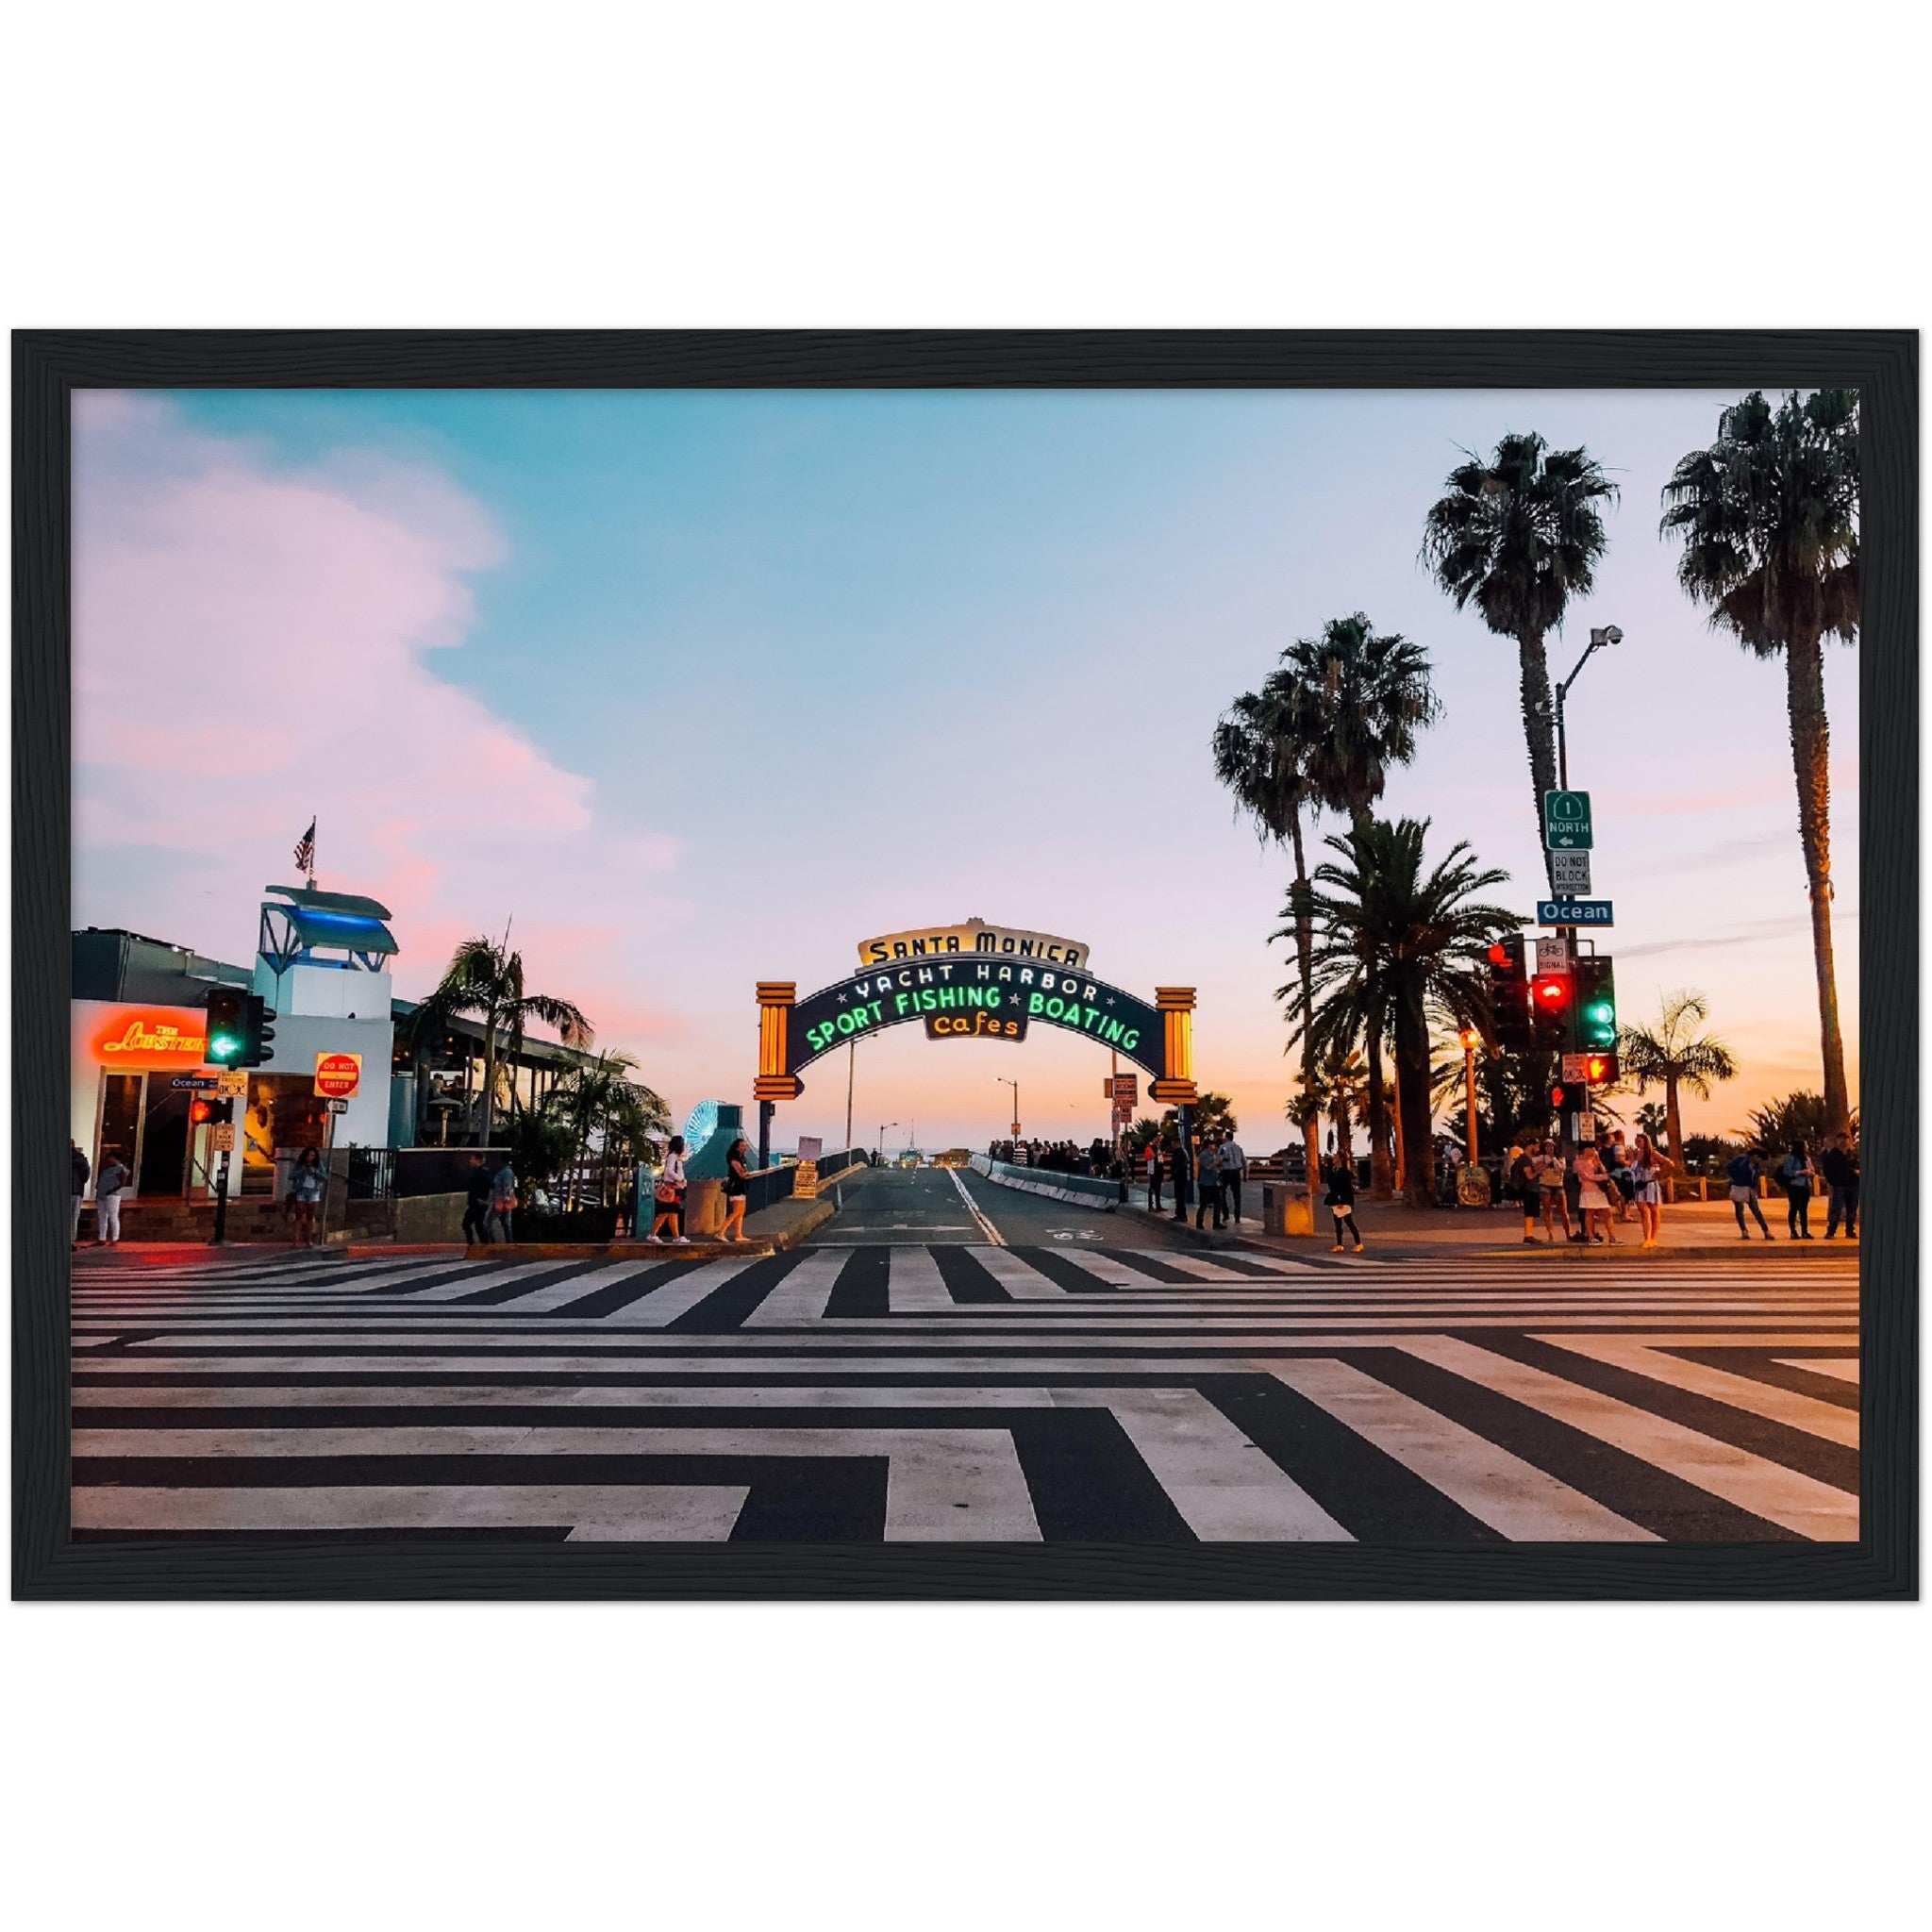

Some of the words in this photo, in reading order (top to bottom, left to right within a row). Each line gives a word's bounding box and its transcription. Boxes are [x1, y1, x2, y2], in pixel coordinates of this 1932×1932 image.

[1565, 801, 1571, 815] 1
[1549, 822, 1590, 833] NORTH
[1555, 856, 1567, 867] DO
[1570, 856, 1587, 867] NOT
[1556, 871, 1588, 881] BLOCK
[1542, 904, 1608, 919] Ocean
[869, 935, 959, 964] SANTA
[975, 931, 1080, 966] MONICA
[1540, 960, 1566, 970] SIGNAL
[855, 964, 953, 998] YACHT
[976, 964, 1098, 1002] HARBOR
[806, 999, 883, 1051] SPORT
[894, 986, 1002, 1016] FISHING
[1027, 991, 1141, 1051] BOATING
[155, 1024, 179, 1036] THE
[324, 1061, 336, 1070] DO
[338, 1062, 355, 1071] NOT
[172, 1078, 205, 1087] Ocean
[325, 1080, 349, 1089] ENTER
